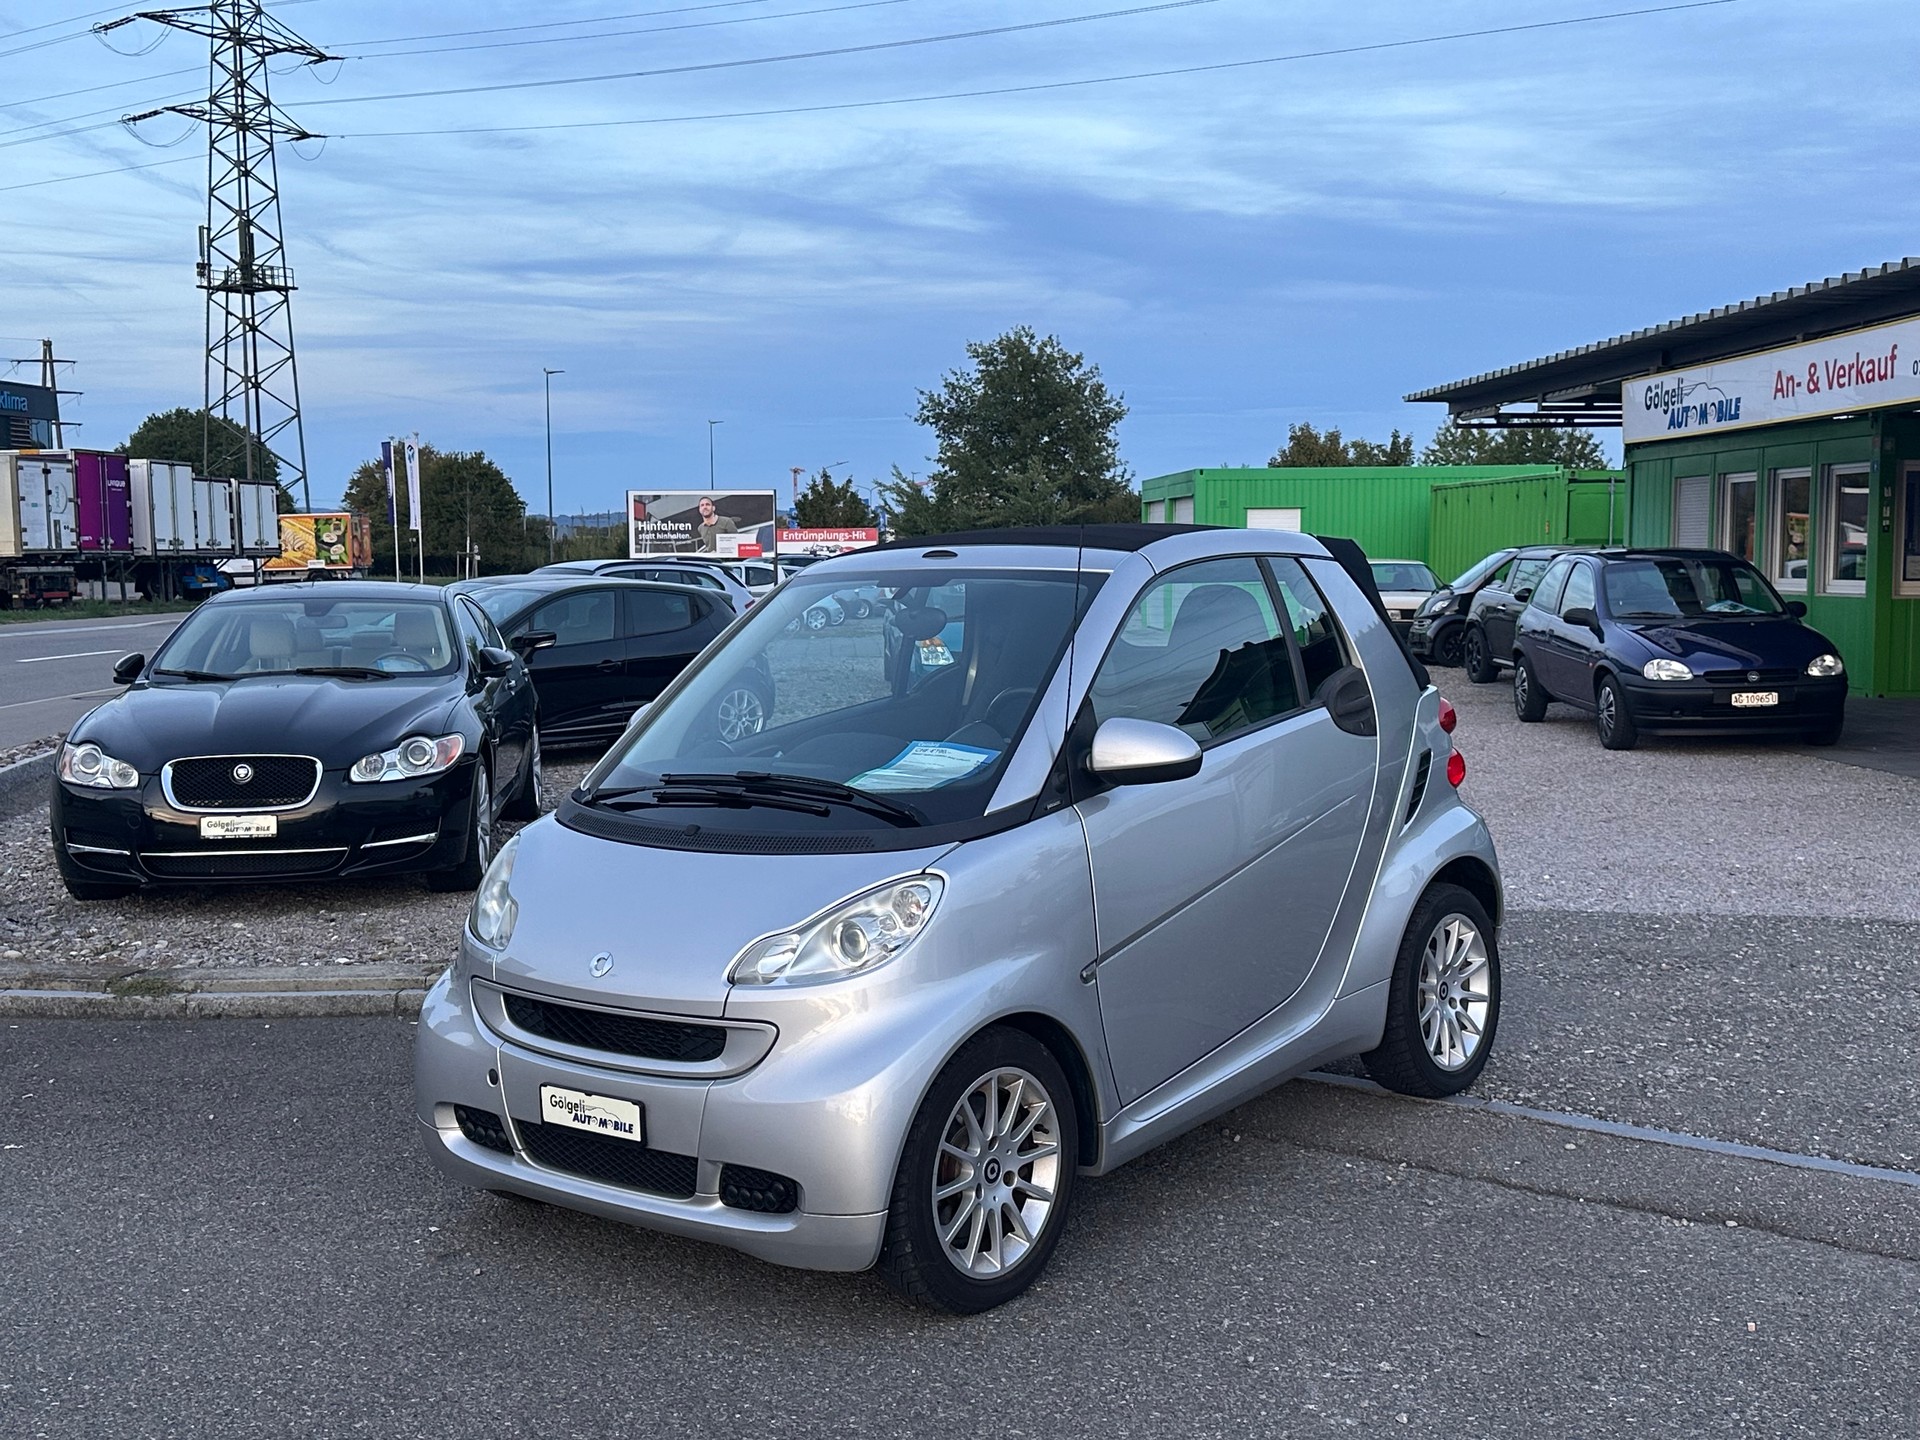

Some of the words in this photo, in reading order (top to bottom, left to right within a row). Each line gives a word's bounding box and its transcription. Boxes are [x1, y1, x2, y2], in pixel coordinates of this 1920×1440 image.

[1773, 370, 1802, 400] An-
[1806, 362, 1820, 394] &
[1825, 344, 1898, 390] Verkauf
[1912, 359, 1920, 376] 0
[1645, 377, 1684, 415] Gölgeli
[638, 520, 692, 531] Hinfahren
[638, 532, 656, 540] statt
[782, 530, 867, 541] Entrümplungs-Hit
[1734, 694, 1743, 703] AG
[207, 820, 235, 829] Gölgeli
[550, 1094, 585, 1113] Gölgeli
